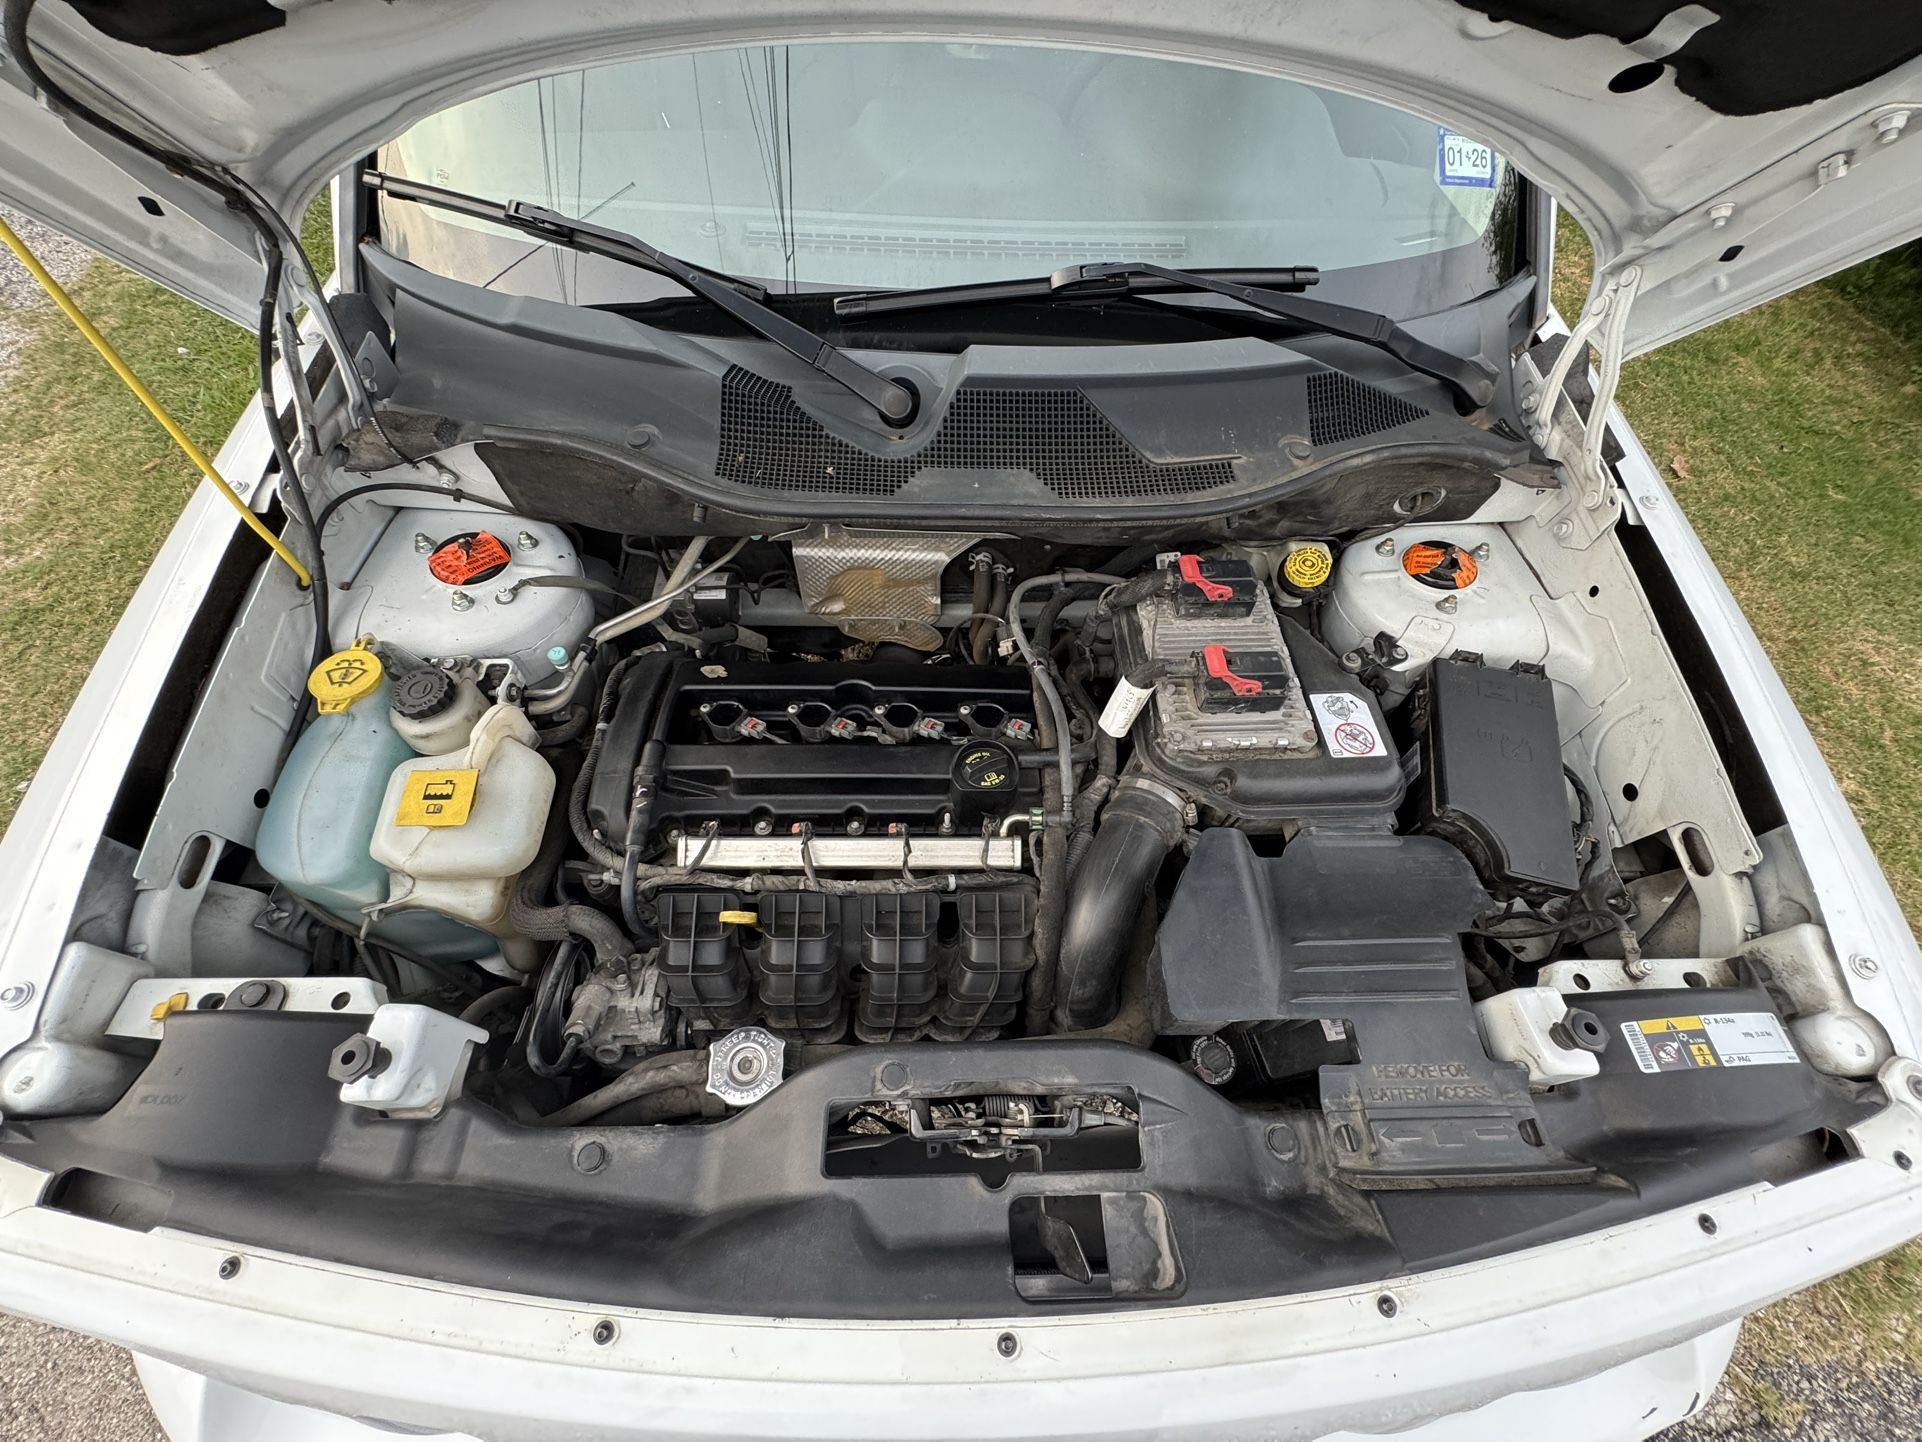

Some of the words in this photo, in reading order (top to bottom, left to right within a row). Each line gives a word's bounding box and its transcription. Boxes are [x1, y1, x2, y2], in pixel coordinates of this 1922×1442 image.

[1447, 147, 1462, 166] 01
[1472, 149, 1487, 168] 26
[467, 555, 504, 573] WARNING
[1371, 1063, 1437, 1079] REMOVE
[1438, 1063, 1471, 1079] FOR
[1369, 1086, 1429, 1102] BATTERY
[1434, 1084, 1493, 1100] ACCESS
